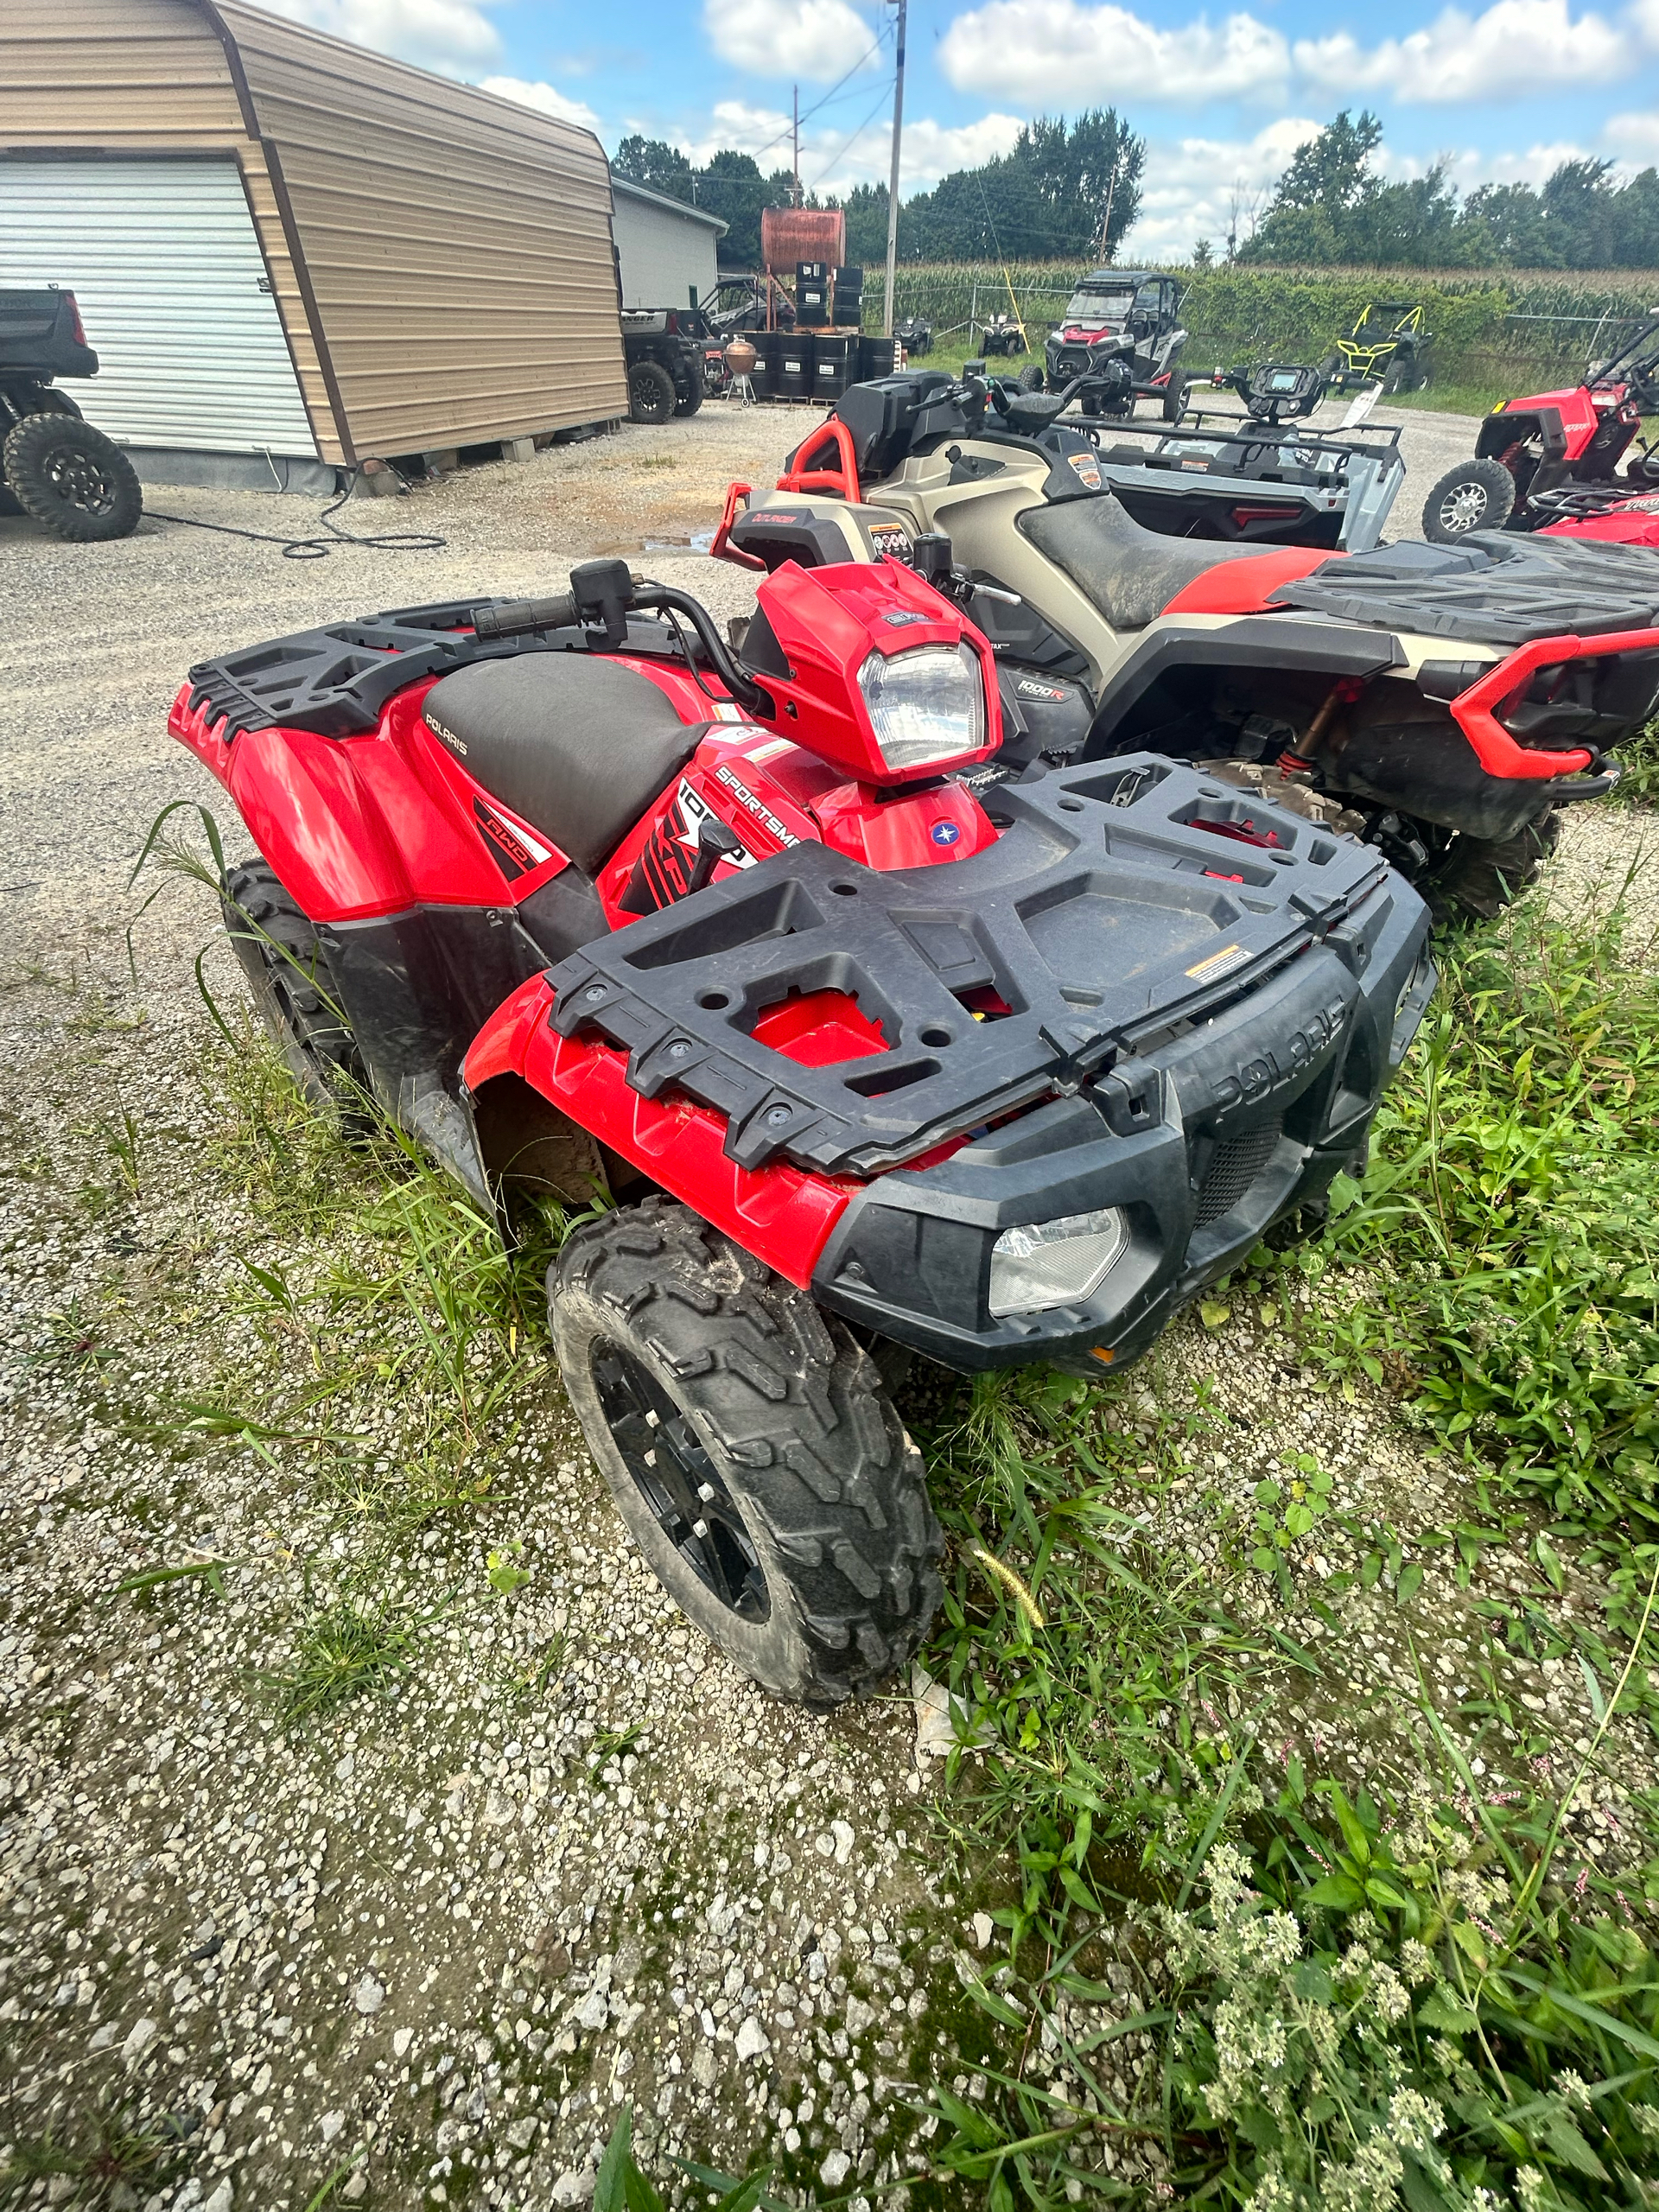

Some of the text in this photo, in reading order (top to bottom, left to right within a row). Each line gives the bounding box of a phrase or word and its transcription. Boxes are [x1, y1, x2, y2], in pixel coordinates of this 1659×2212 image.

[1018, 679, 1065, 701] 1000R
[425, 713, 468, 756] POLARIS
[714, 766, 801, 849] SPORTSMA
[486, 817, 529, 863] AWD
[1210, 993, 1346, 1124] POLARIS
